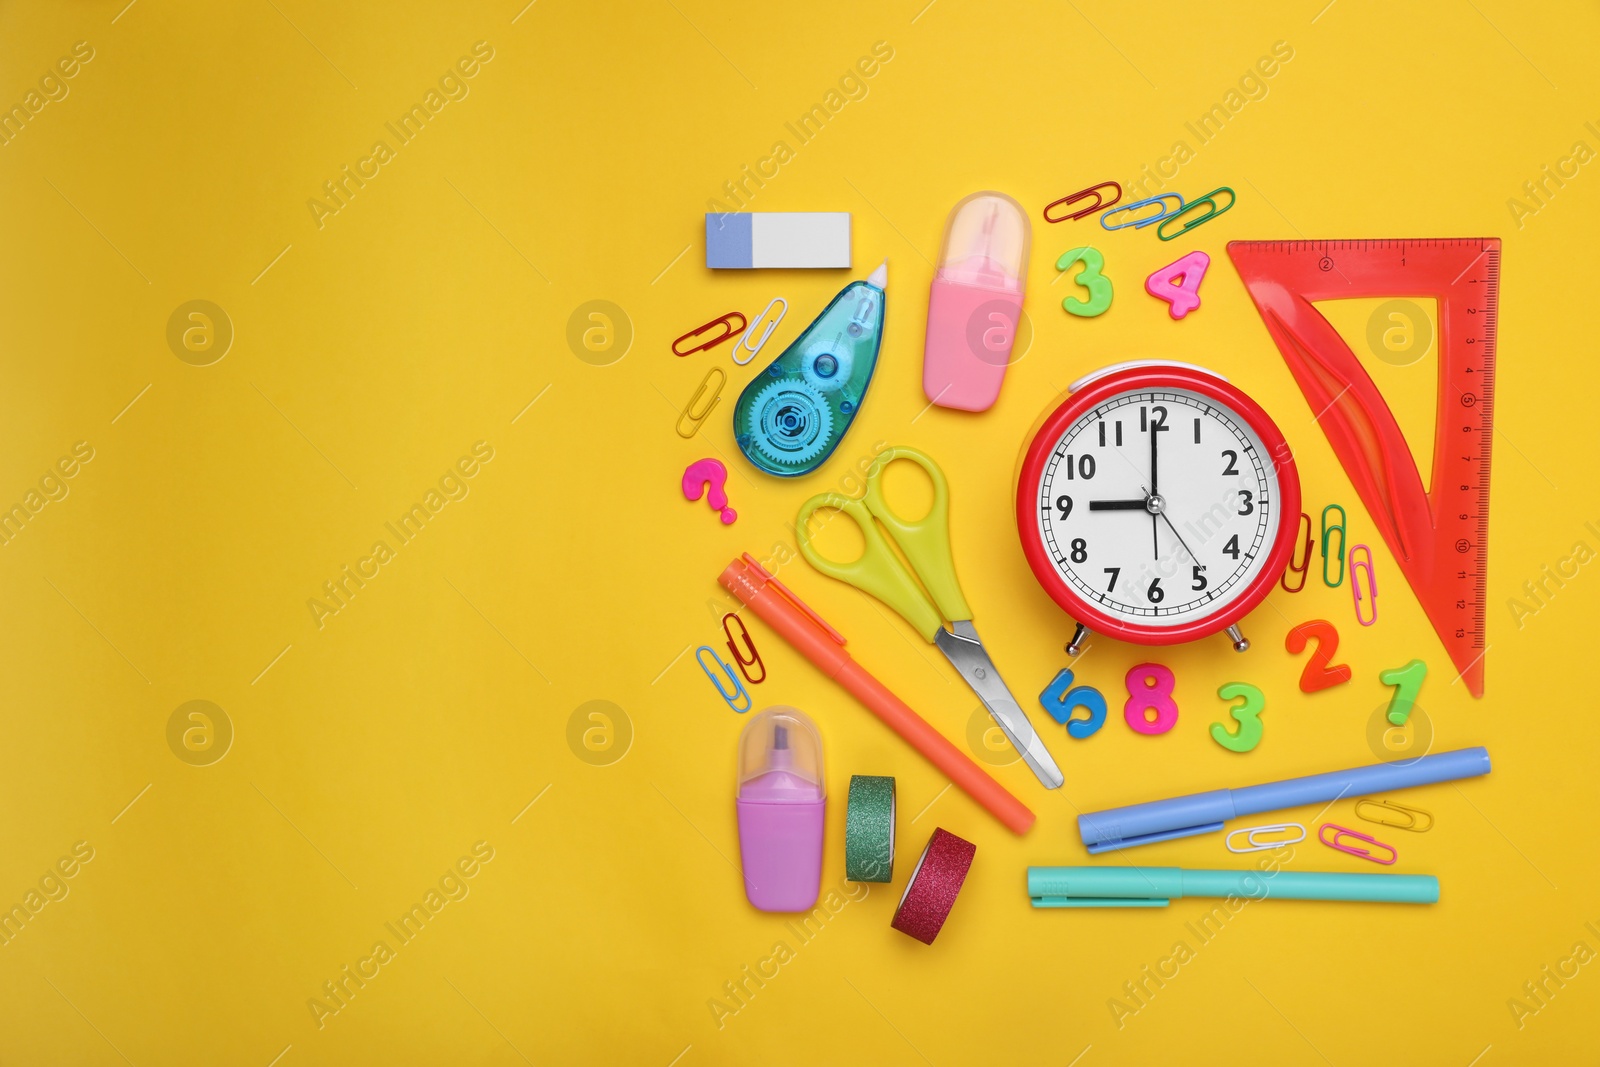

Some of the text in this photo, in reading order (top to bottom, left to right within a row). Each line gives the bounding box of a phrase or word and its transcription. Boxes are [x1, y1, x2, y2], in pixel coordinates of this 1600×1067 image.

[1055, 246, 1114, 318] 3
[1144, 250, 1210, 320] 4
[1140, 406, 1170, 432] 12
[1194, 418, 1201, 444] 1
[1098, 420, 1122, 447] 11
[1067, 454, 1096, 480] 10
[1221, 450, 1239, 476] 2
[1056, 495, 1073, 520] 9
[1237, 490, 1254, 516] 3
[1070, 538, 1088, 564] 8
[1222, 534, 1240, 560] 4
[1104, 568, 1120, 592] 7
[1192, 566, 1208, 591] 5
[1458, 571, 1466, 580] 11
[1147, 578, 1164, 604] 6
[1456, 600, 1466, 610] 12
[1456, 628, 1464, 638] 13
[1285, 619, 1352, 694] 2
[1038, 668, 1108, 739] 5
[1124, 662, 1178, 735] 8
[1379, 659, 1428, 726] 1
[1209, 682, 1265, 753] 3
